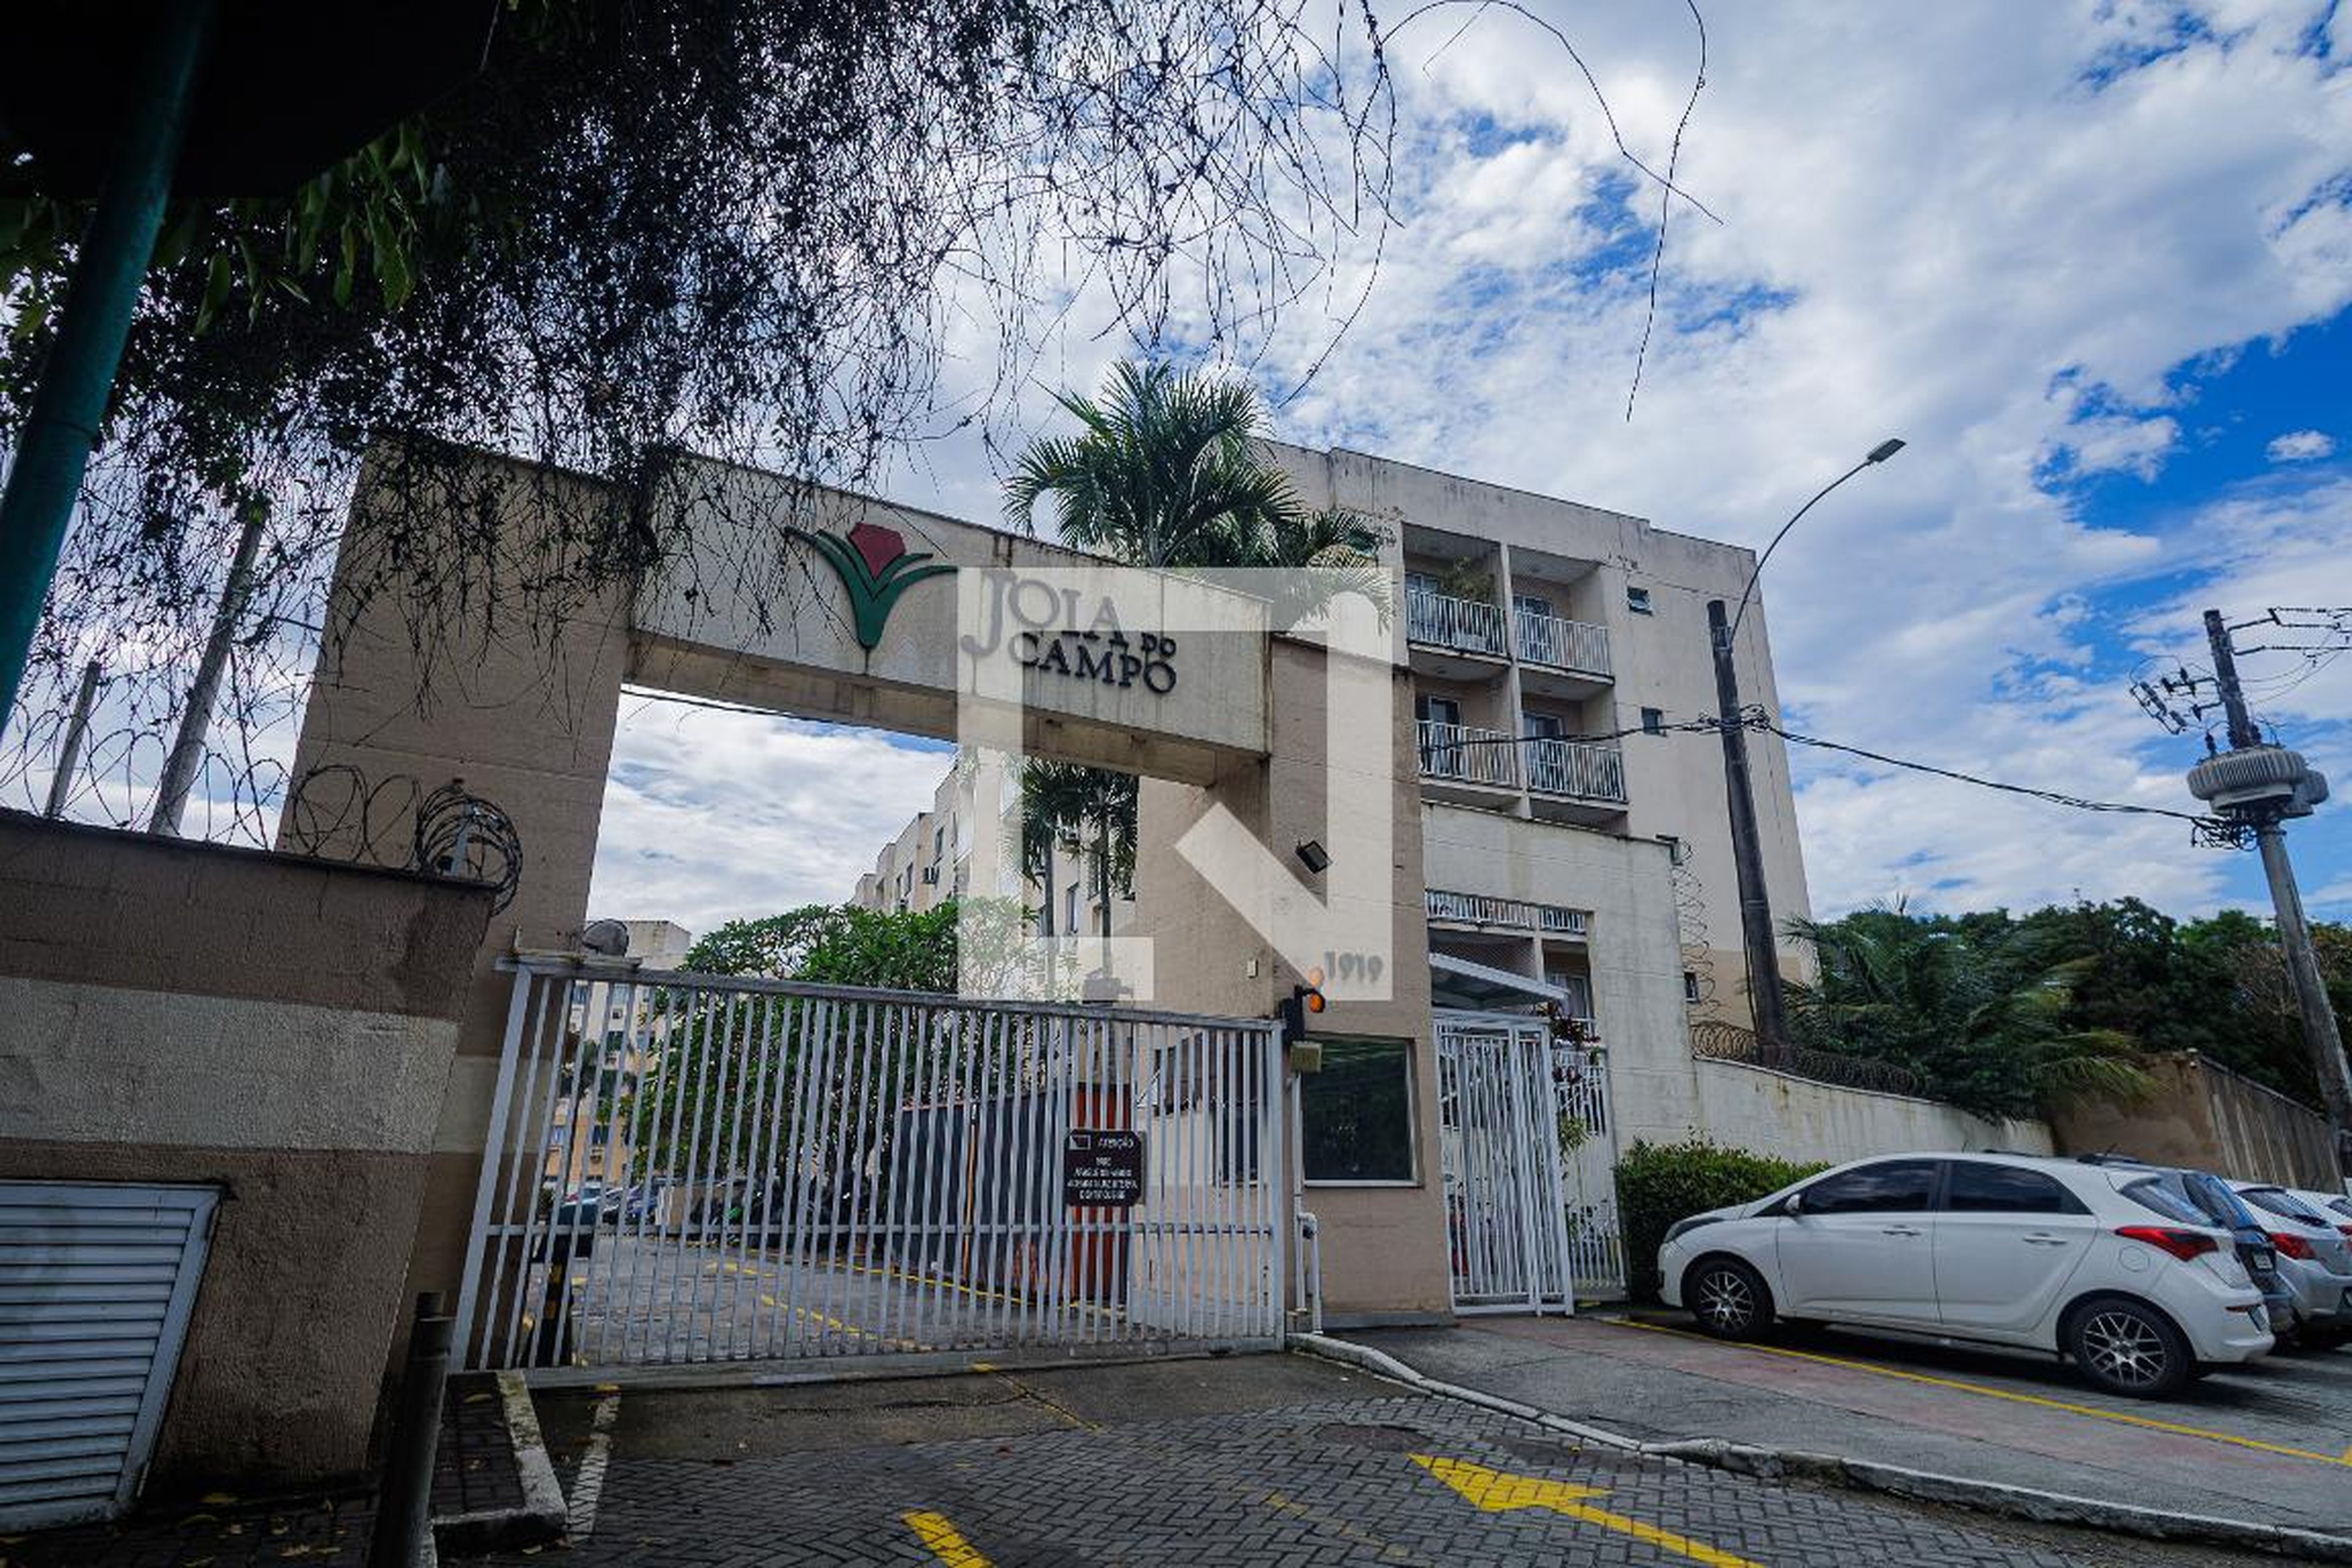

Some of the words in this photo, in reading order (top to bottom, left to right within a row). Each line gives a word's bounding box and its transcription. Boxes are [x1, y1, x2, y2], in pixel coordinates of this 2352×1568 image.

[960, 567, 1129, 657] JOIA
[1008, 630, 1177, 694] CAMPO
[1324, 951, 1384, 983] 1919
